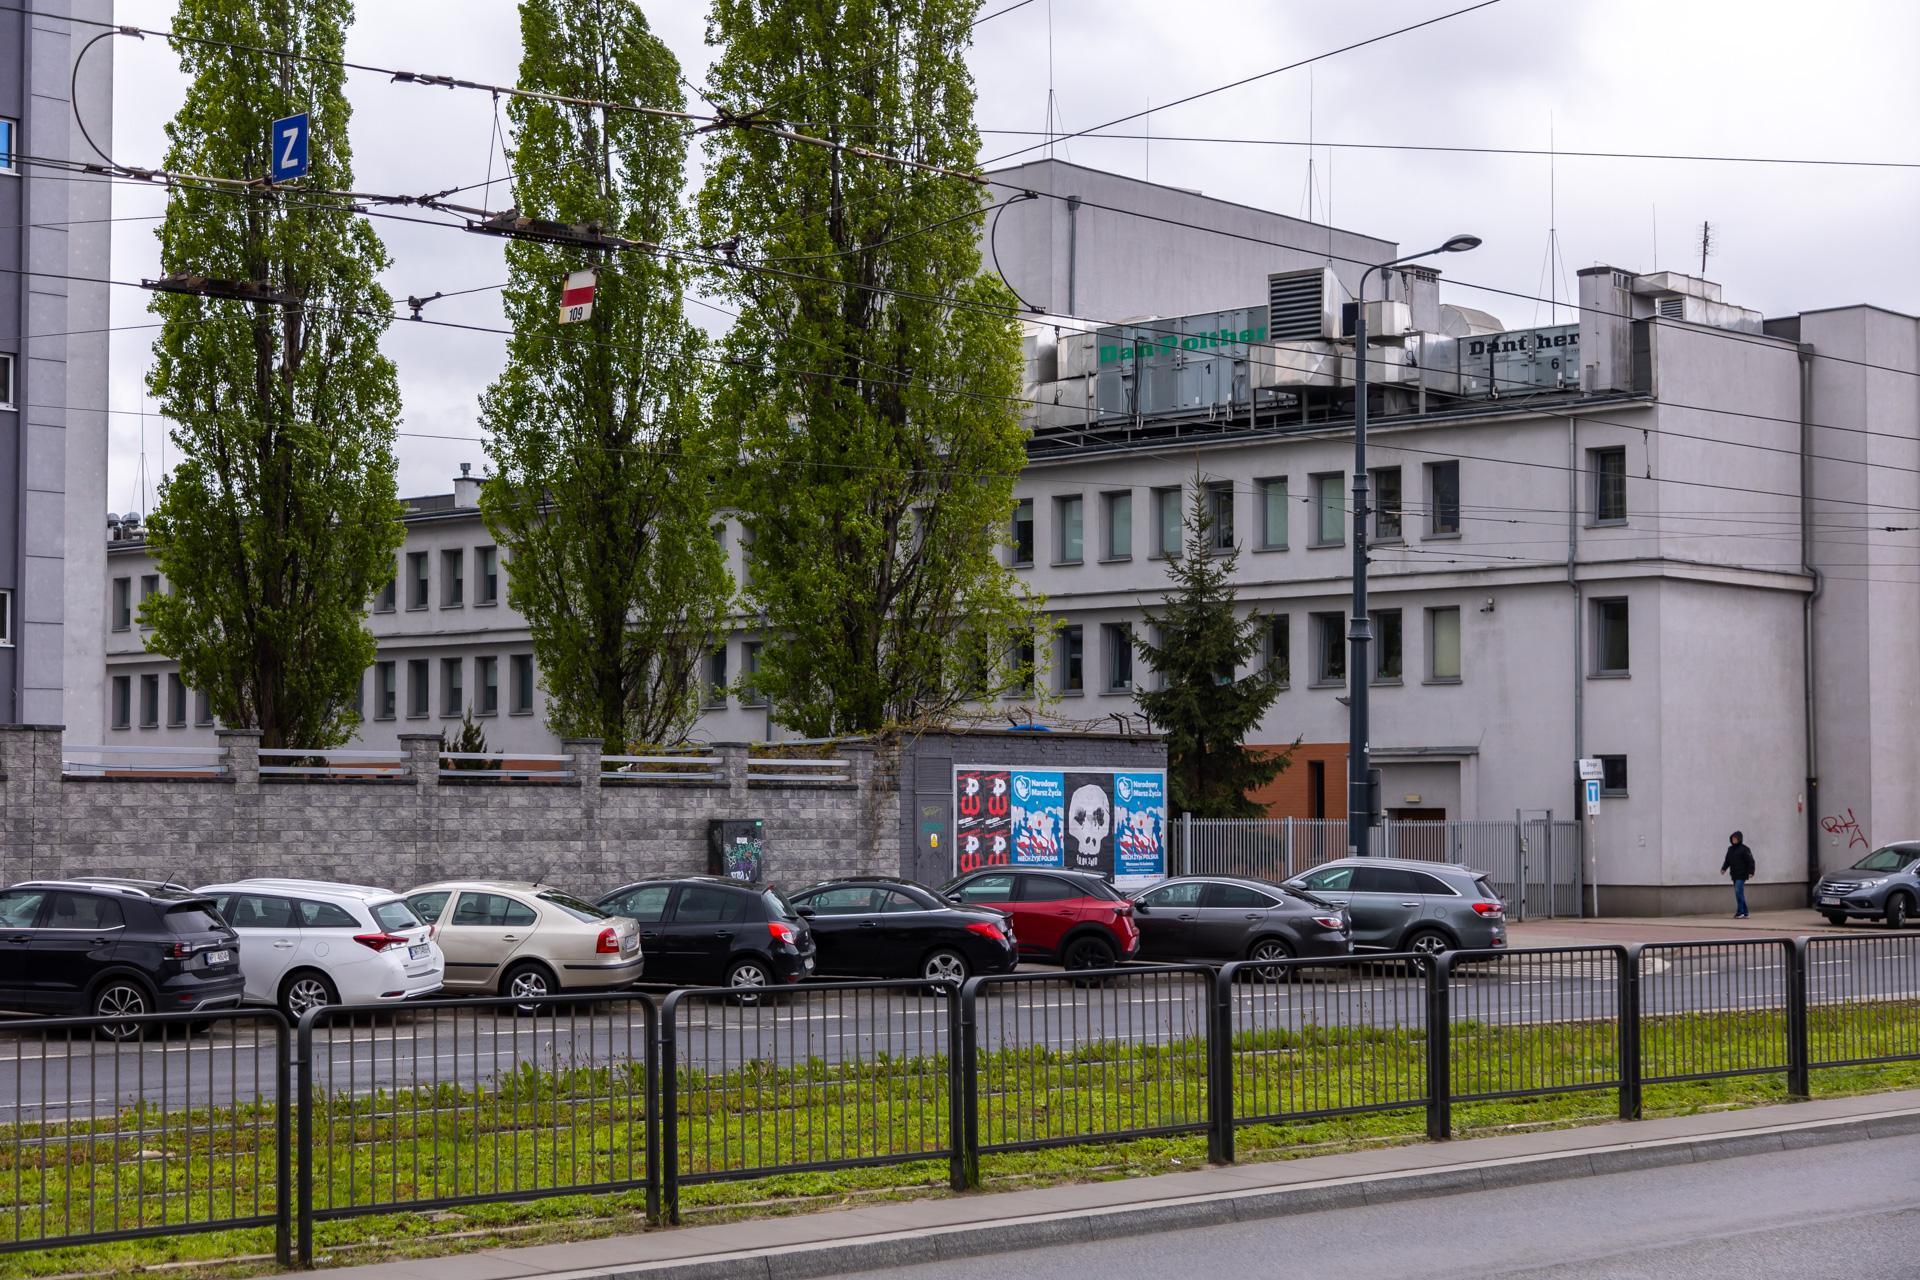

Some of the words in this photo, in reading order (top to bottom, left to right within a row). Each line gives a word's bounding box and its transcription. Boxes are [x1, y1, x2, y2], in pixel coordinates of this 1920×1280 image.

[282, 128, 298, 169] Z
[569, 307, 583, 321] 109
[1205, 363, 1211, 375] 1
[1551, 358, 1559, 370] 6
[1031, 779, 1058, 789] Narodowy
[1133, 780, 1158, 789] Narodowy
[1031, 789, 1047, 797] Marsz
[1047, 787, 1061, 798] Życia
[1133, 789, 1148, 797] Marsz
[1148, 788, 1161, 798] Życia
